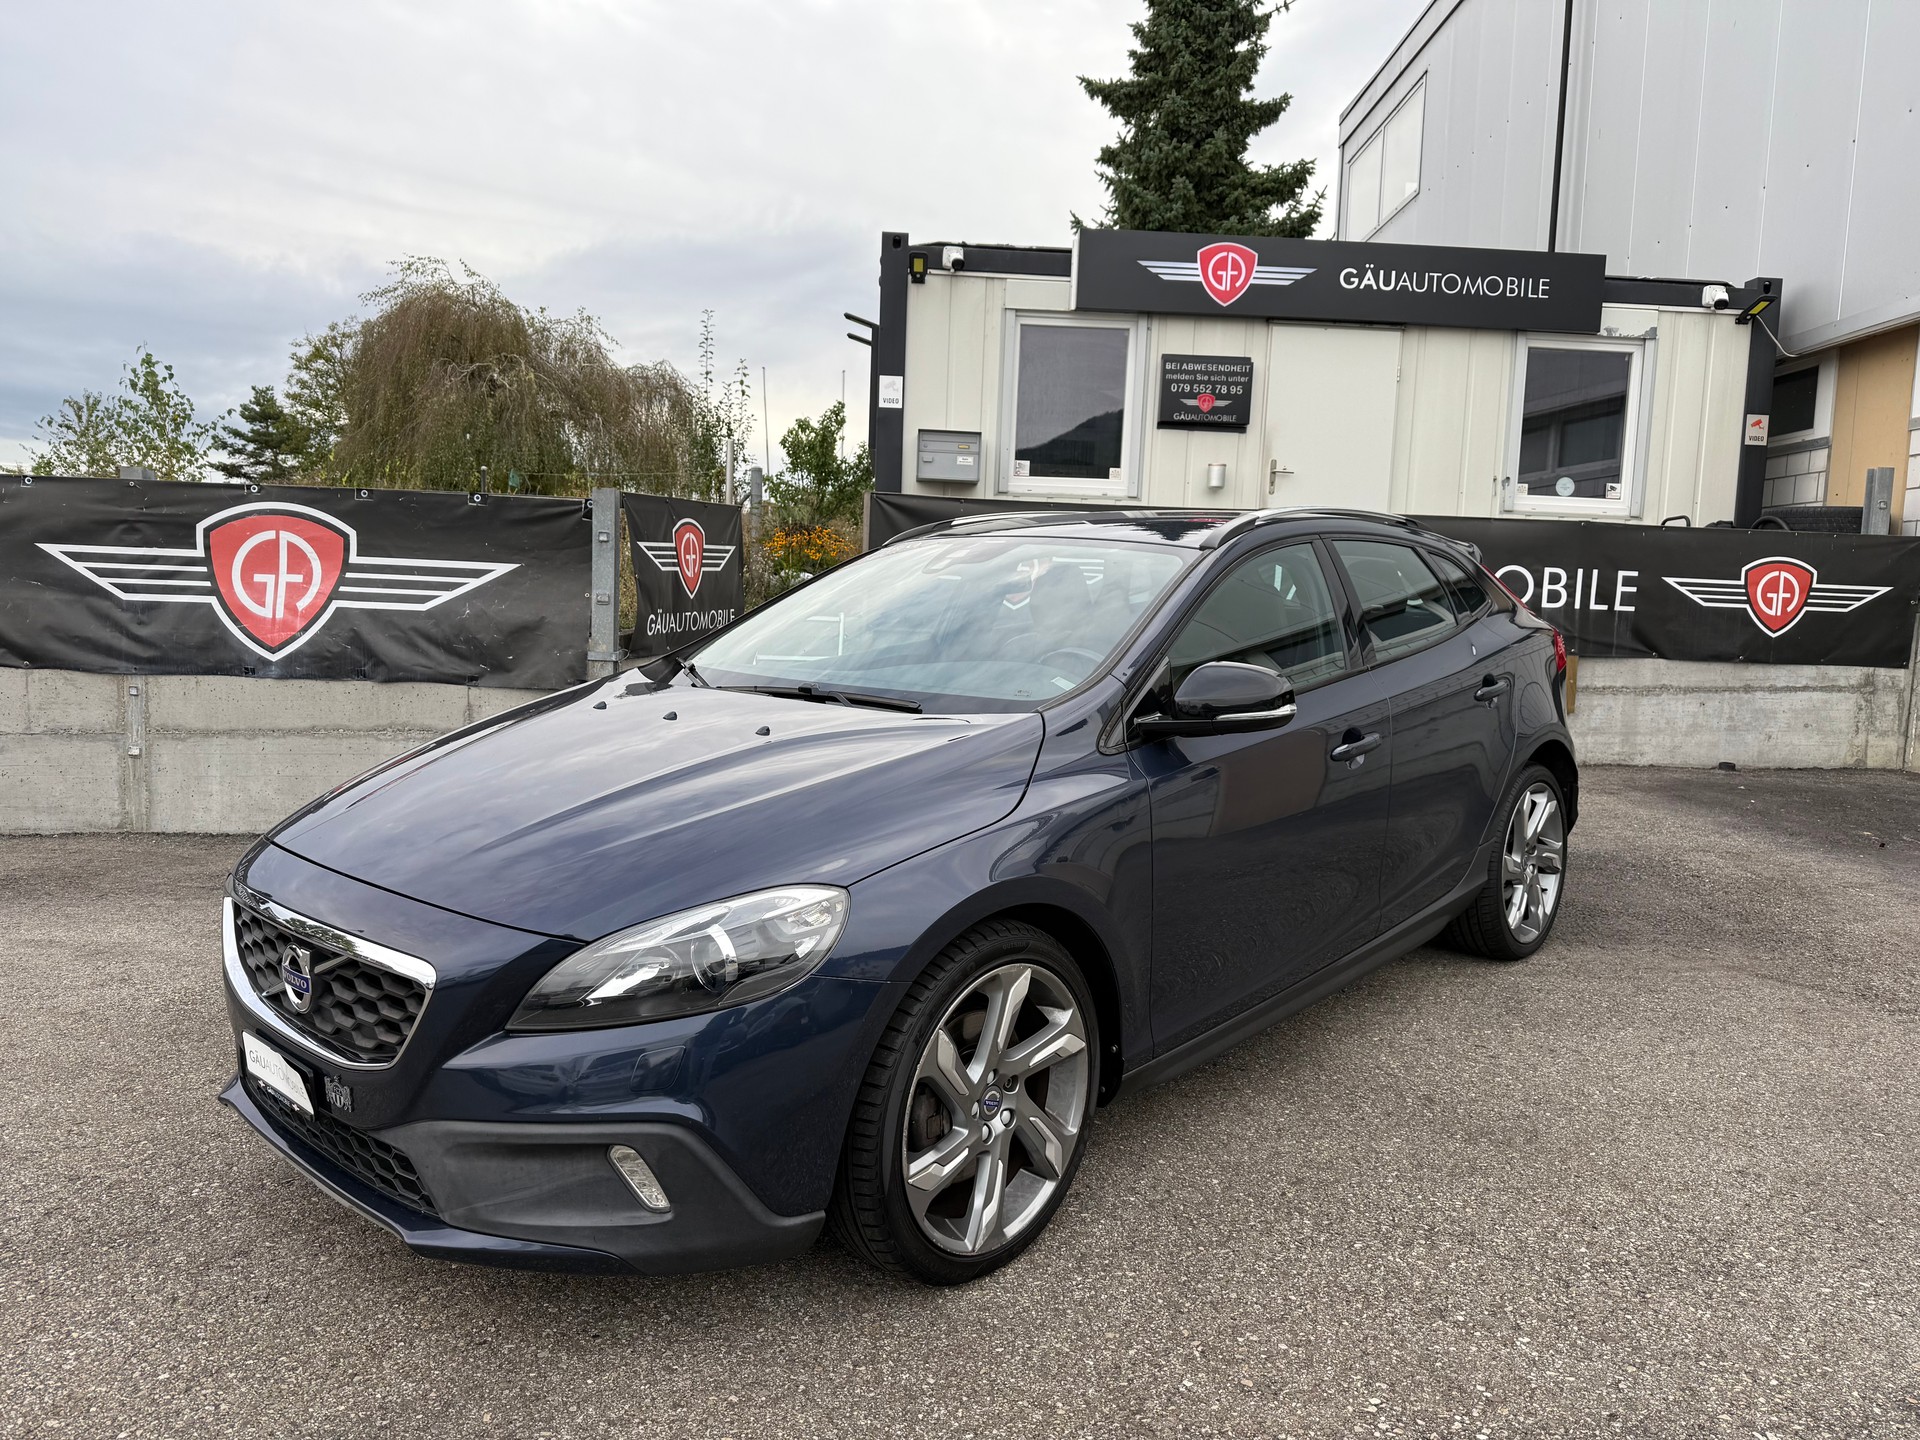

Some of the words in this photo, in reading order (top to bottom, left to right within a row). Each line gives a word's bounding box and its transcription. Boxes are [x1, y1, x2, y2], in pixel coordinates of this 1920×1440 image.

[1339, 263, 1551, 299] GÄUAUTOMOBILE
[1165, 362, 1180, 370] BEI
[1181, 363, 1251, 373] ABWESENDHEIT
[1165, 373, 1195, 381] melden
[1196, 373, 1209, 381] Sie
[1210, 374, 1227, 382] sich
[1171, 383, 1191, 393] 079
[1193, 384, 1213, 393] 552
[1215, 384, 1228, 394] 78
[1230, 385, 1243, 394] 95
[882, 397, 900, 405] VIDEO
[1173, 411, 1237, 422] GÄUAUTOMOBILE
[646, 608, 736, 637] GÄUAUTOMOBILE
[283, 970, 308, 989] VOLVO
